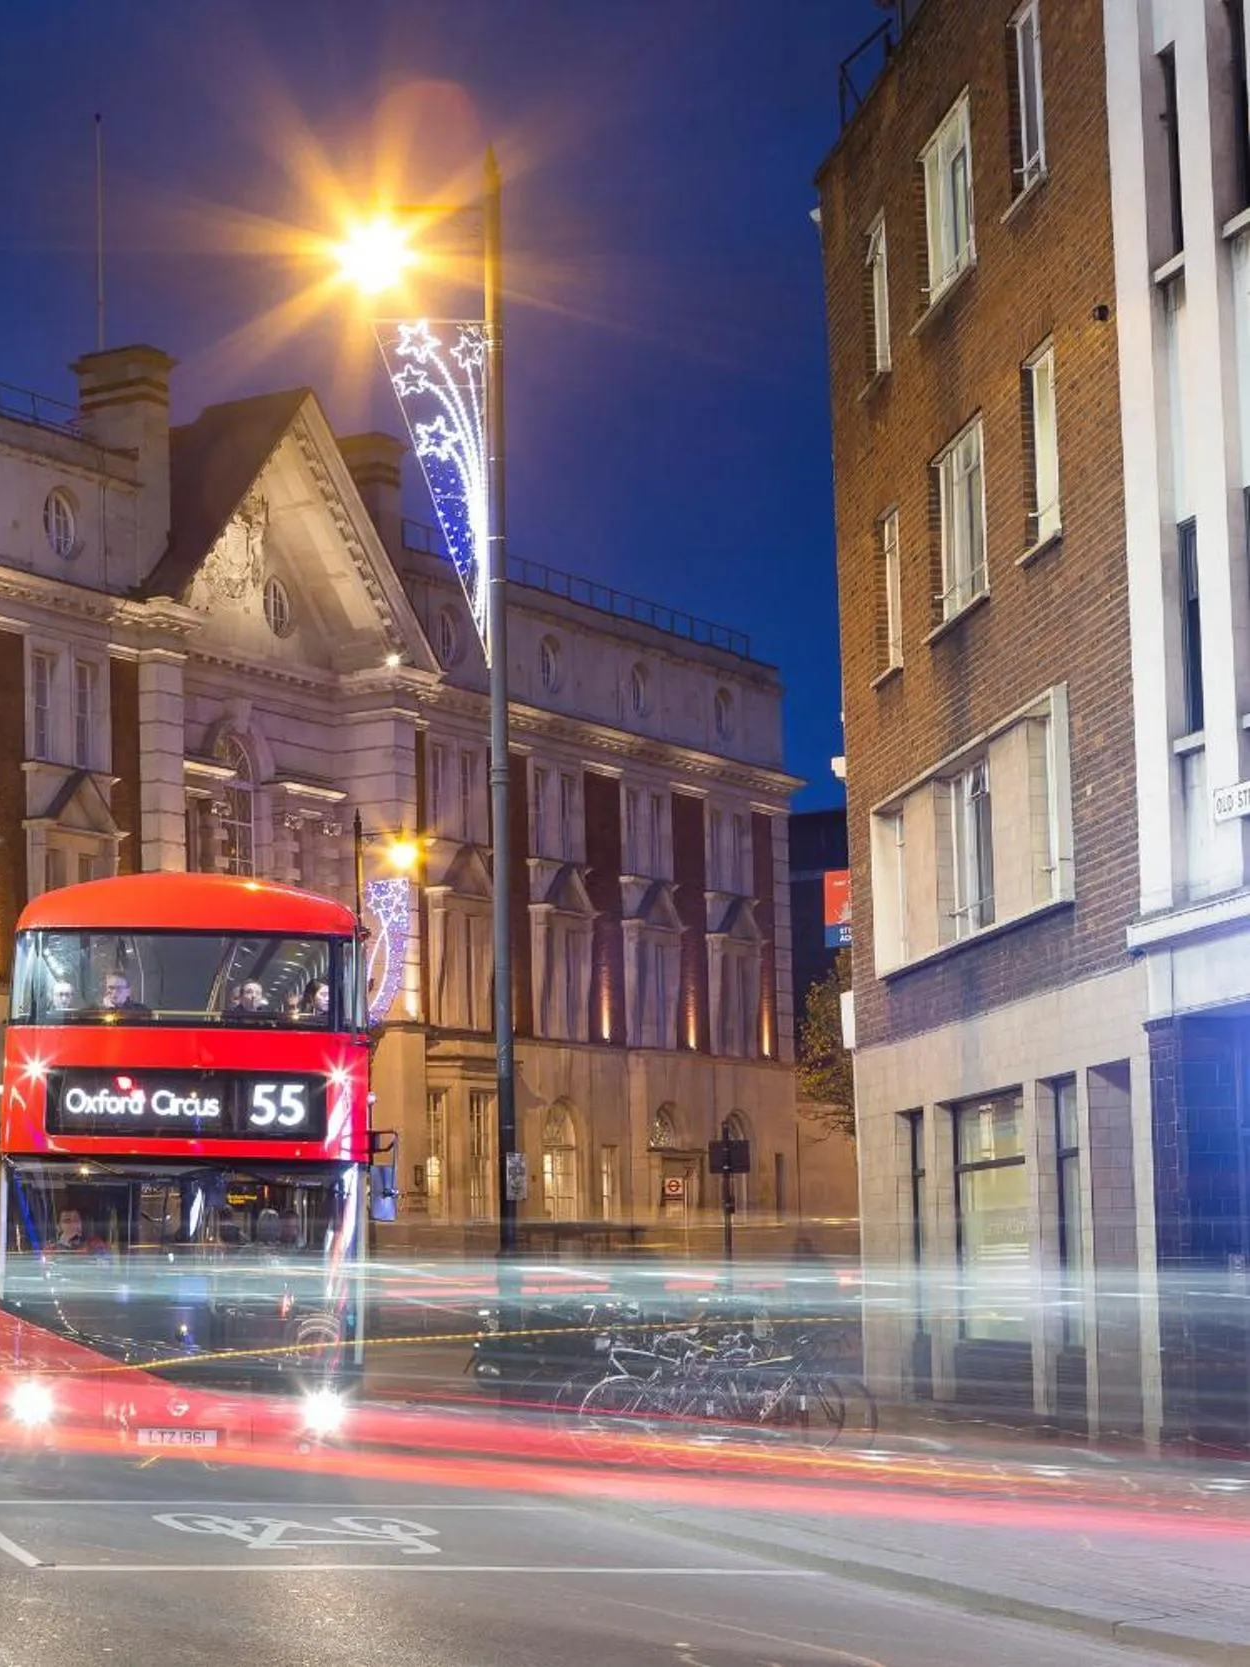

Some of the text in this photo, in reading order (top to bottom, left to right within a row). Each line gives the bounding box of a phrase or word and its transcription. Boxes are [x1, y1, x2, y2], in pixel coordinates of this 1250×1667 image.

[65, 1084, 307, 1126] Oxford Circus 55
